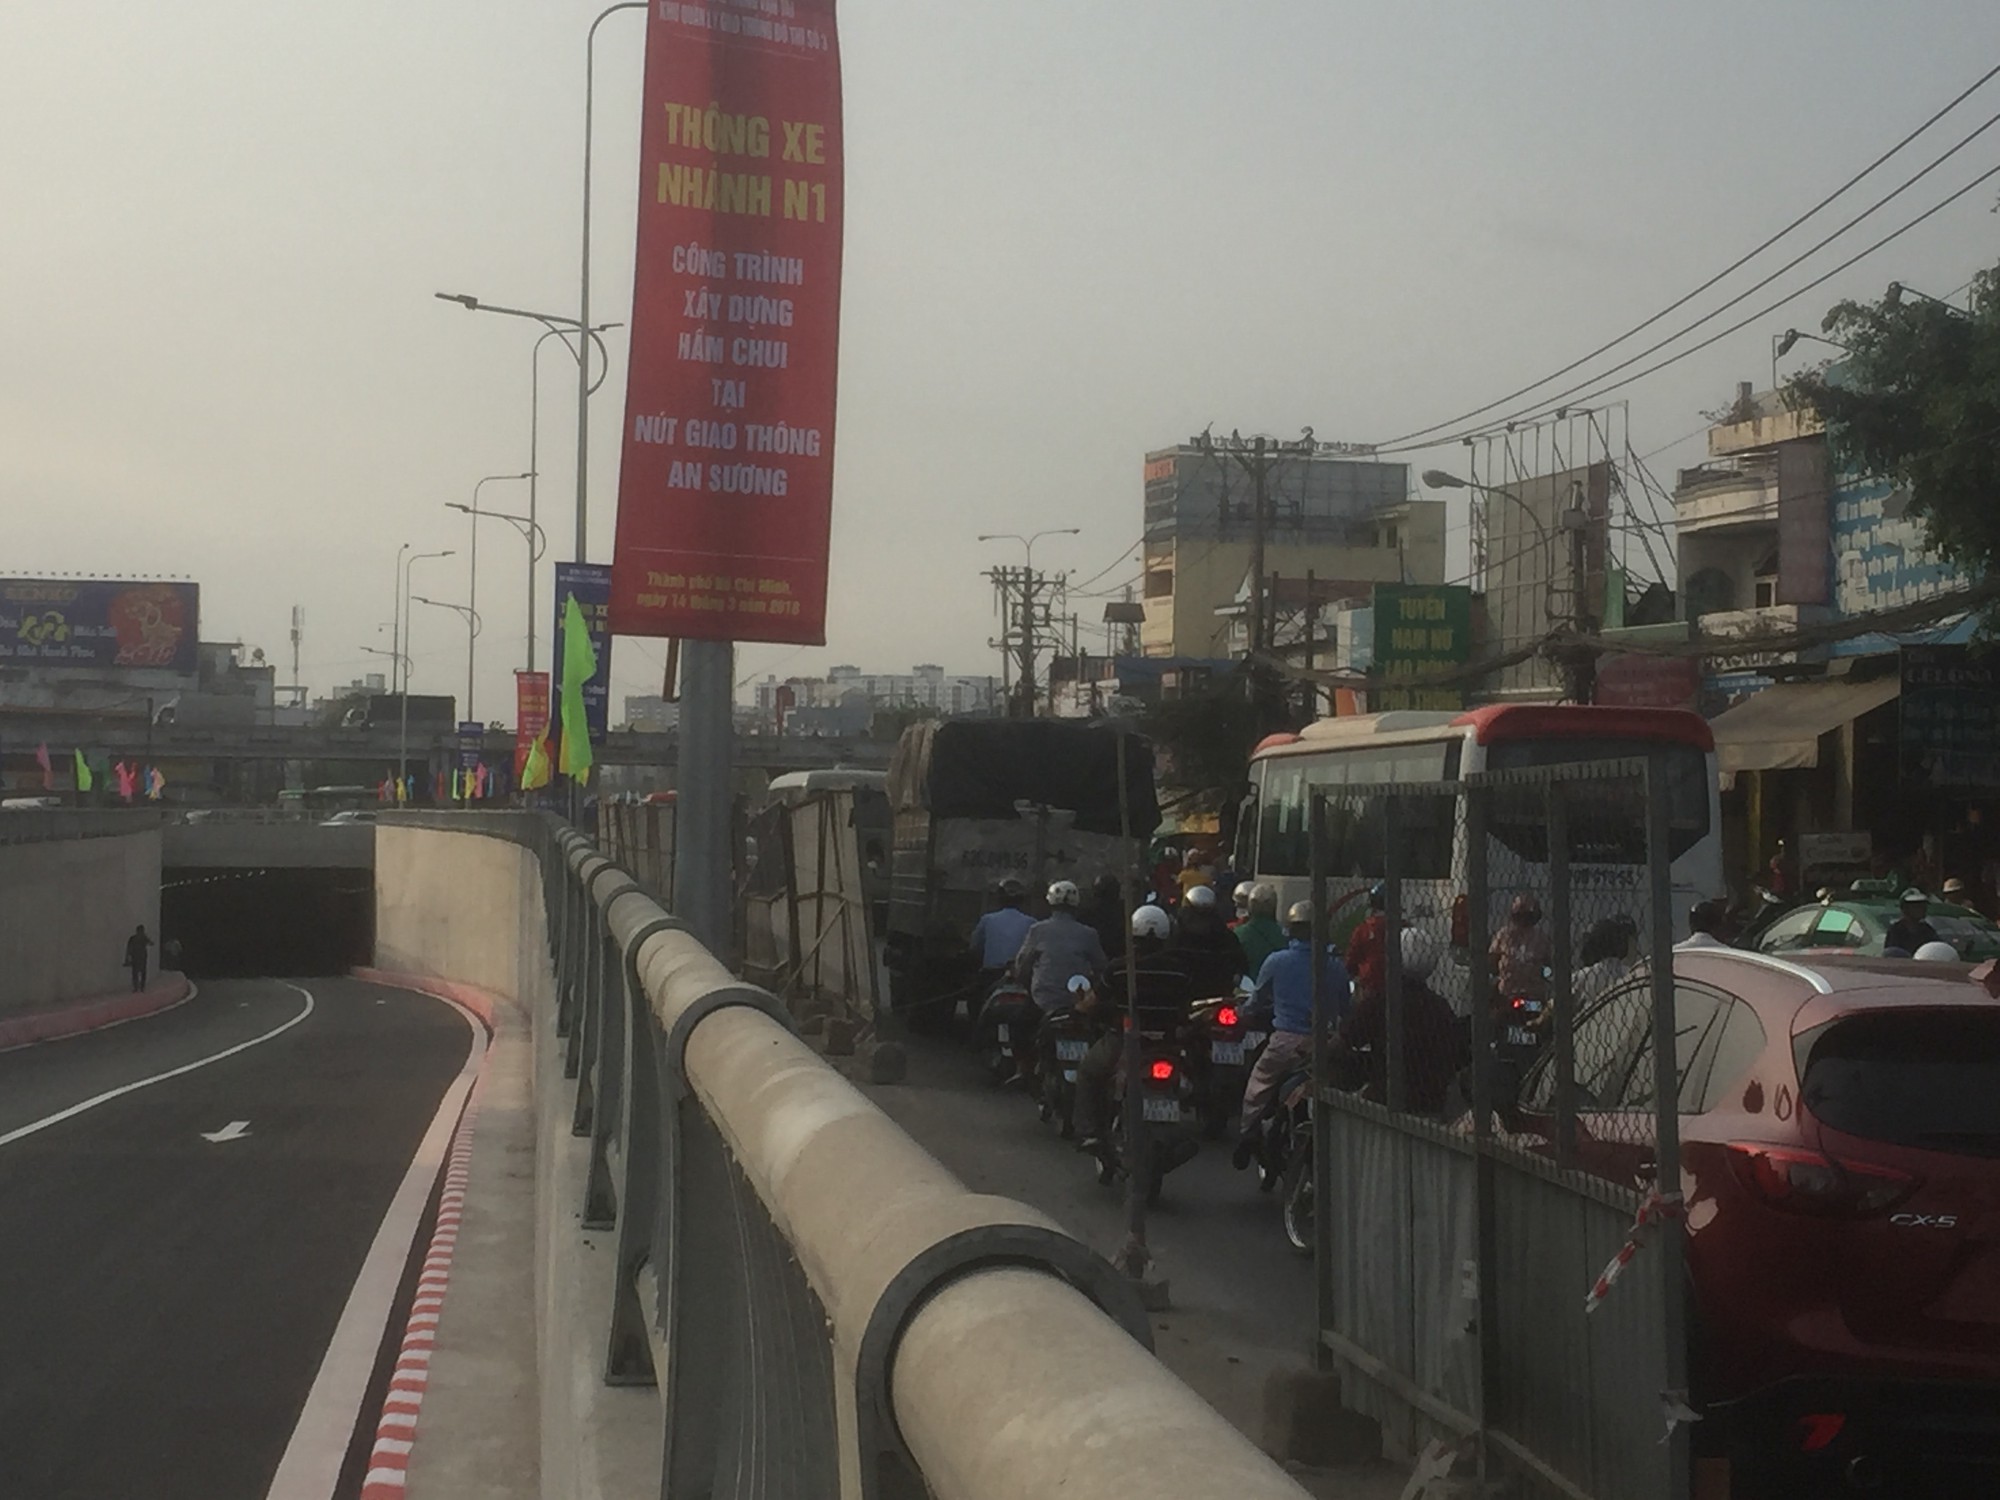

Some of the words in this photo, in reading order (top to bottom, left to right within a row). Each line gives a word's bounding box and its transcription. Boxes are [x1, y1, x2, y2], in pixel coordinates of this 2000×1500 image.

[664, 101, 770, 157] THÔNG
[782, 120, 825, 164] XE
[657, 162, 771, 216] NHÁNH
[783, 179, 825, 223] N1
[672, 241, 727, 278] CÔNG
[734, 250, 803, 285] TRÌNH
[684, 286, 723, 320] XÂY
[728, 295, 793, 330] DỰNG
[732, 337, 788, 368] CHUI
[712, 378, 746, 413] TẠI
[635, 411, 678, 445] NÚT
[685, 419, 737, 450] GIAO
[745, 421, 821, 456] THÔNG
[668, 461, 702, 490] AN
[709, 462, 787, 497] SƯƠNG
[647, 571, 685, 588] Thành
[672, 593, 687, 608] 14
[769, 599, 801, 617] 2018
[1890, 1212, 1958, 1229] CX-5
